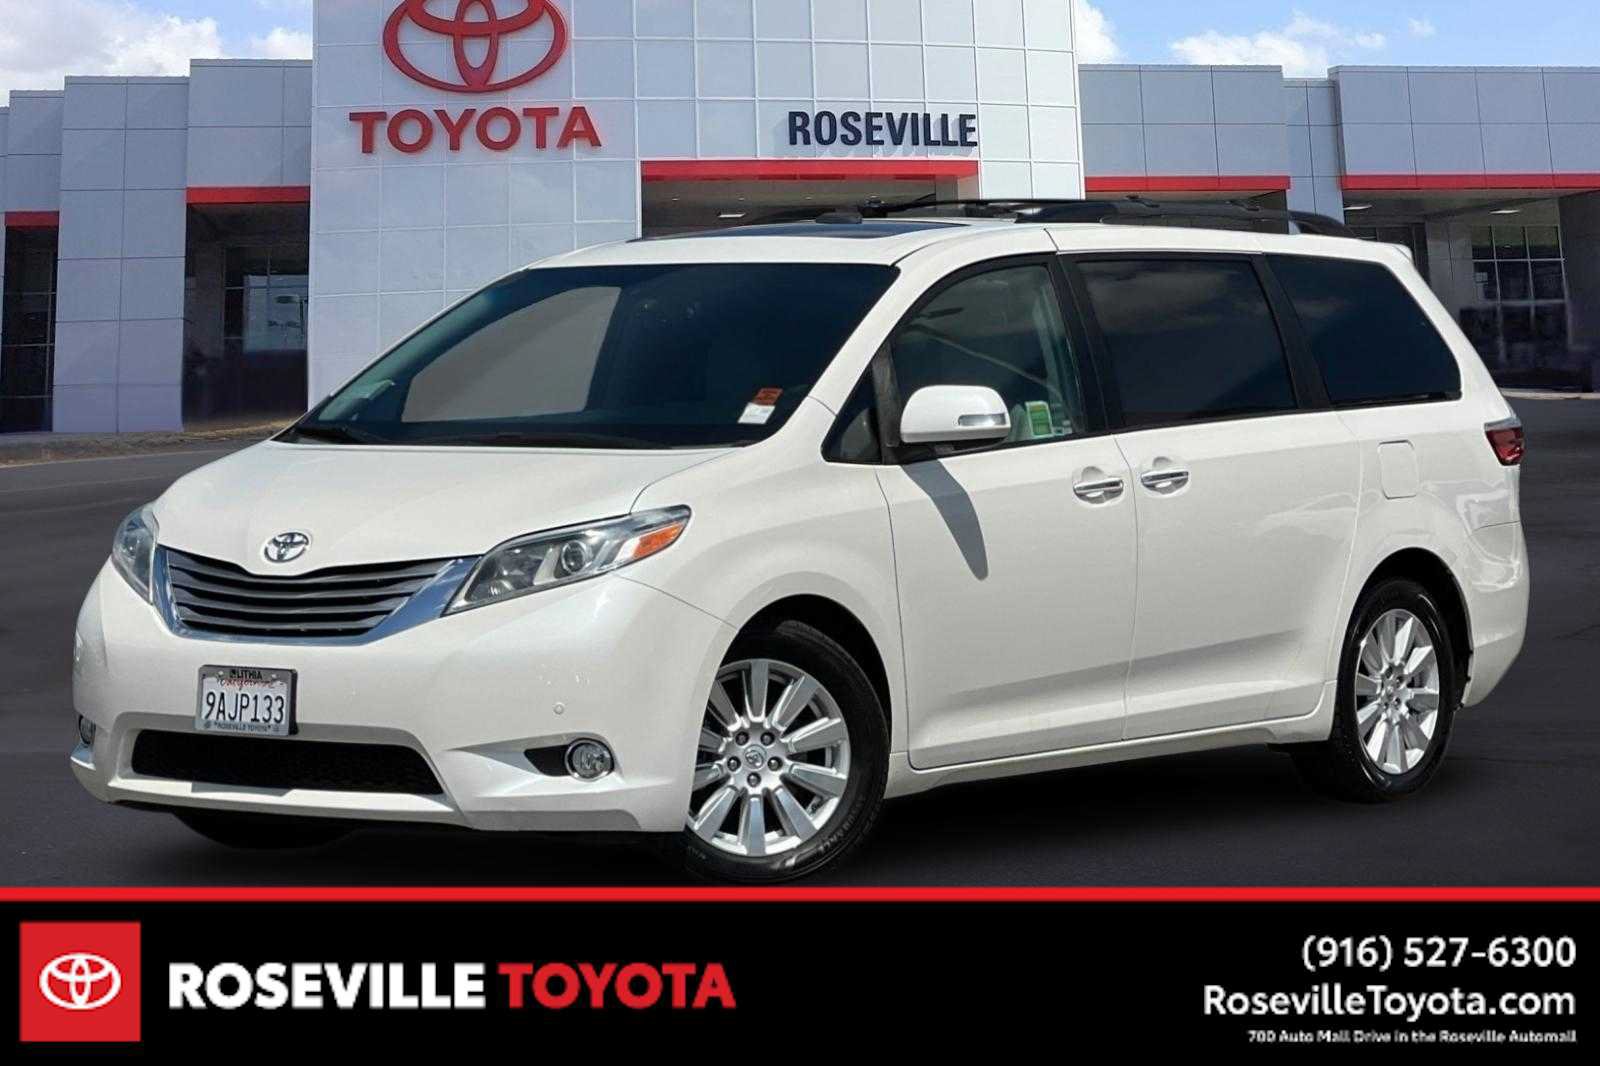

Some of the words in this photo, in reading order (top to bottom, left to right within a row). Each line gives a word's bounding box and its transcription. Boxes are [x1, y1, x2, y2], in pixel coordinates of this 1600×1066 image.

[349, 105, 602, 154] TOYOTA
[789, 111, 978, 147] ROSEVILLE
[237, 670, 263, 680] LITHIA
[204, 692, 285, 723] 9AJP133
